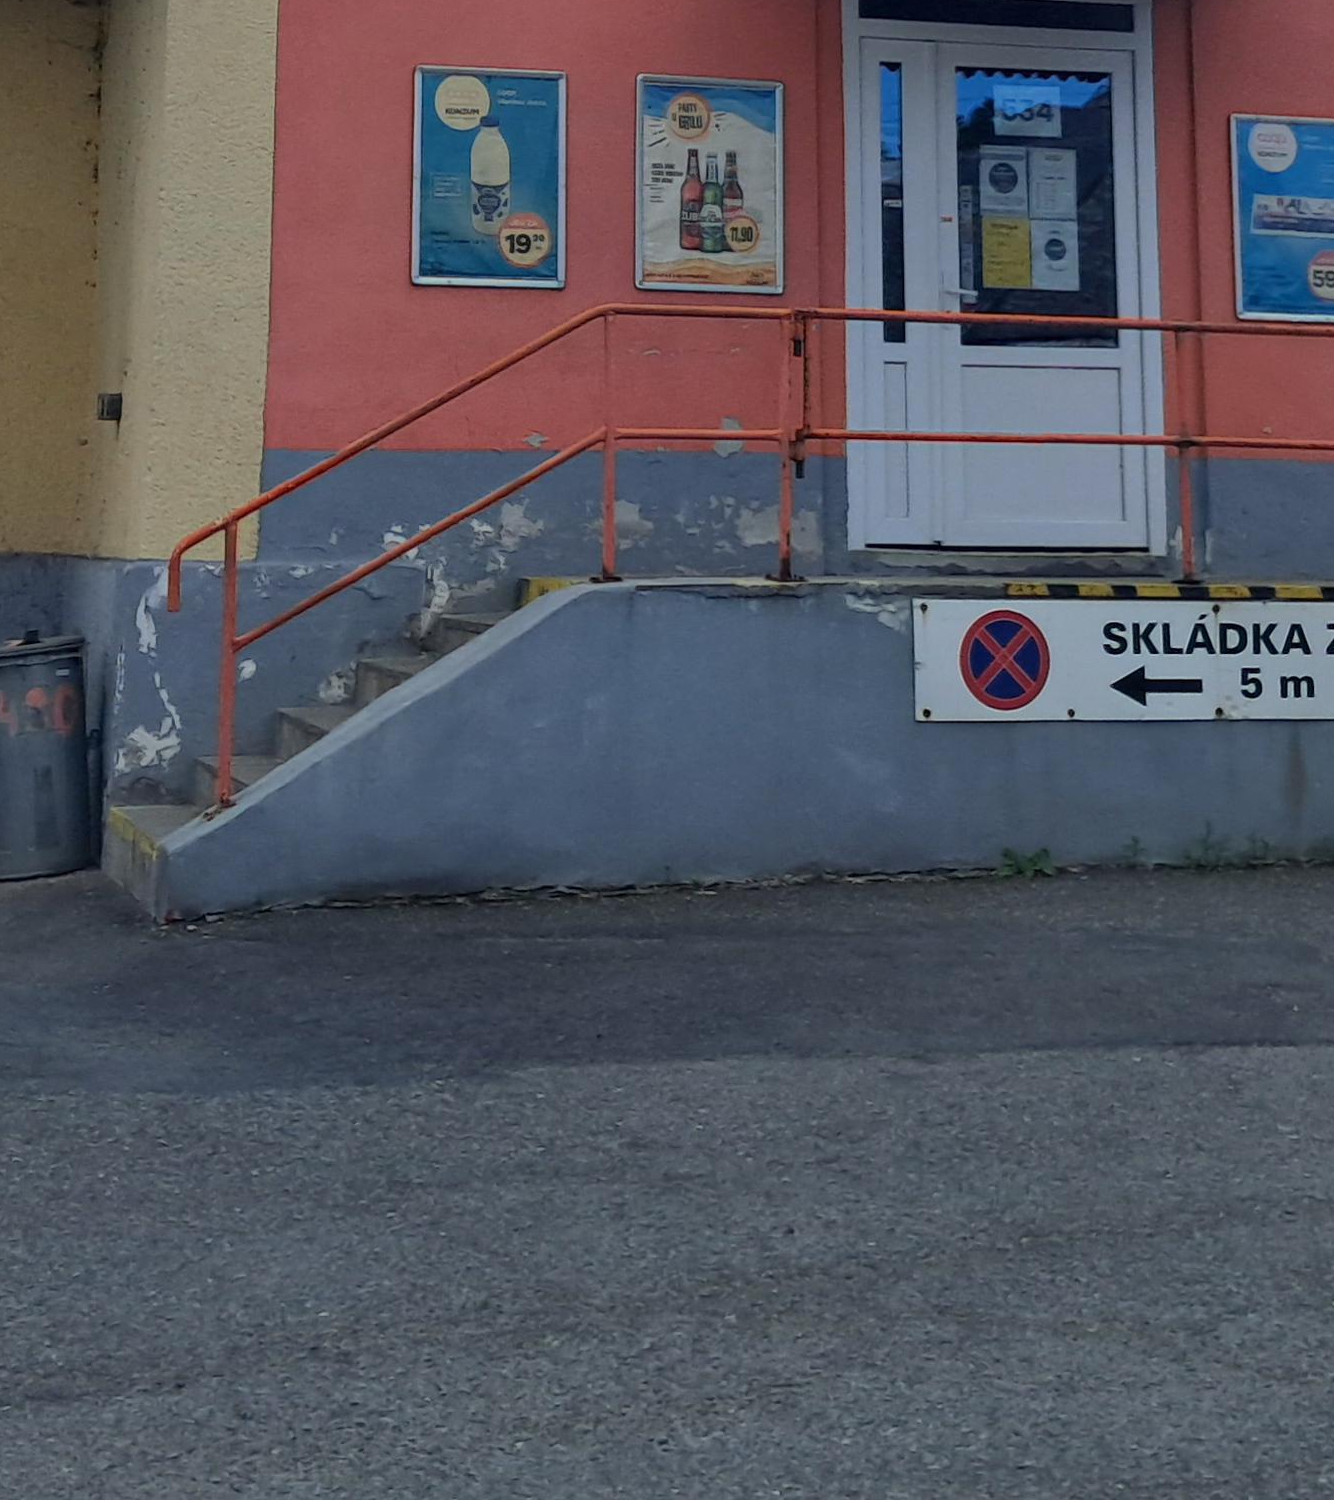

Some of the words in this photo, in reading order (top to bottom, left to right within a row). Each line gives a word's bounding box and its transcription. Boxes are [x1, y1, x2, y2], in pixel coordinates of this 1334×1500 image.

[505, 233, 532, 254] 19
[1102, 613, 1312, 656] SKLÁDKA
[1240, 667, 1264, 699] 5
[1279, 674, 1315, 699] m
